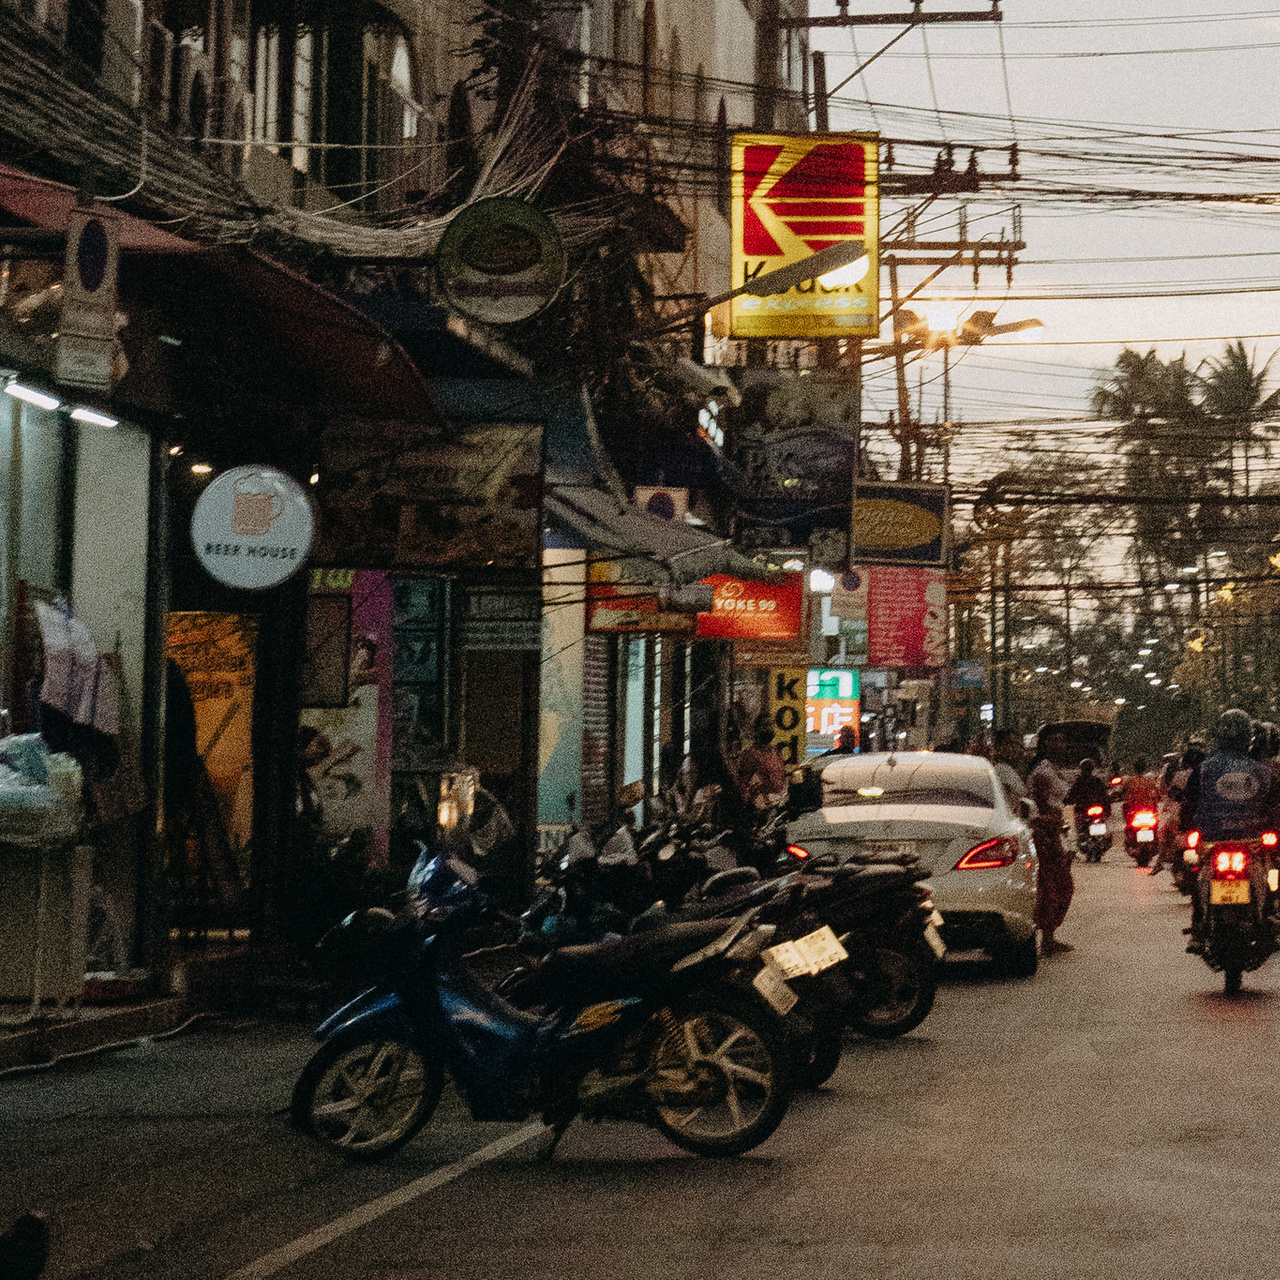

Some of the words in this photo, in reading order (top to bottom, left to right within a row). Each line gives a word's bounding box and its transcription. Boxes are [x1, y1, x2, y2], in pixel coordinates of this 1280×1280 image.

[205, 543, 241, 555] BEER
[247, 546, 297, 559] HOUSE
[714, 598, 757, 611] YOKE
[758, 599, 776, 611] 99
